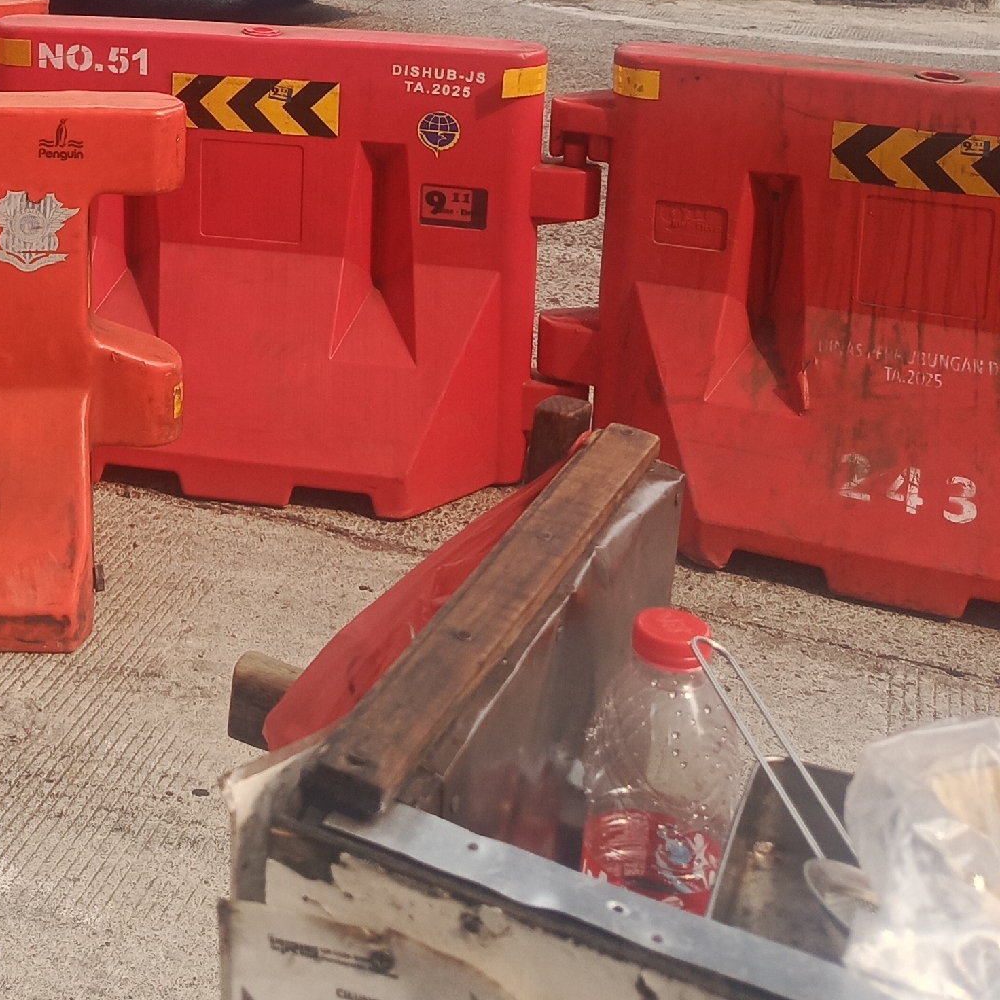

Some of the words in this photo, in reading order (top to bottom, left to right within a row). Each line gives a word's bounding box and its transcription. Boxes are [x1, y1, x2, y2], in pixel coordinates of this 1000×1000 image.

[38, 42, 148, 76] NO.51
[392, 64, 486, 84] DISHUB-JS
[404, 81, 471, 98] TA.2025
[39, 149, 84, 161] Penguin
[425, 190, 446, 215] 9
